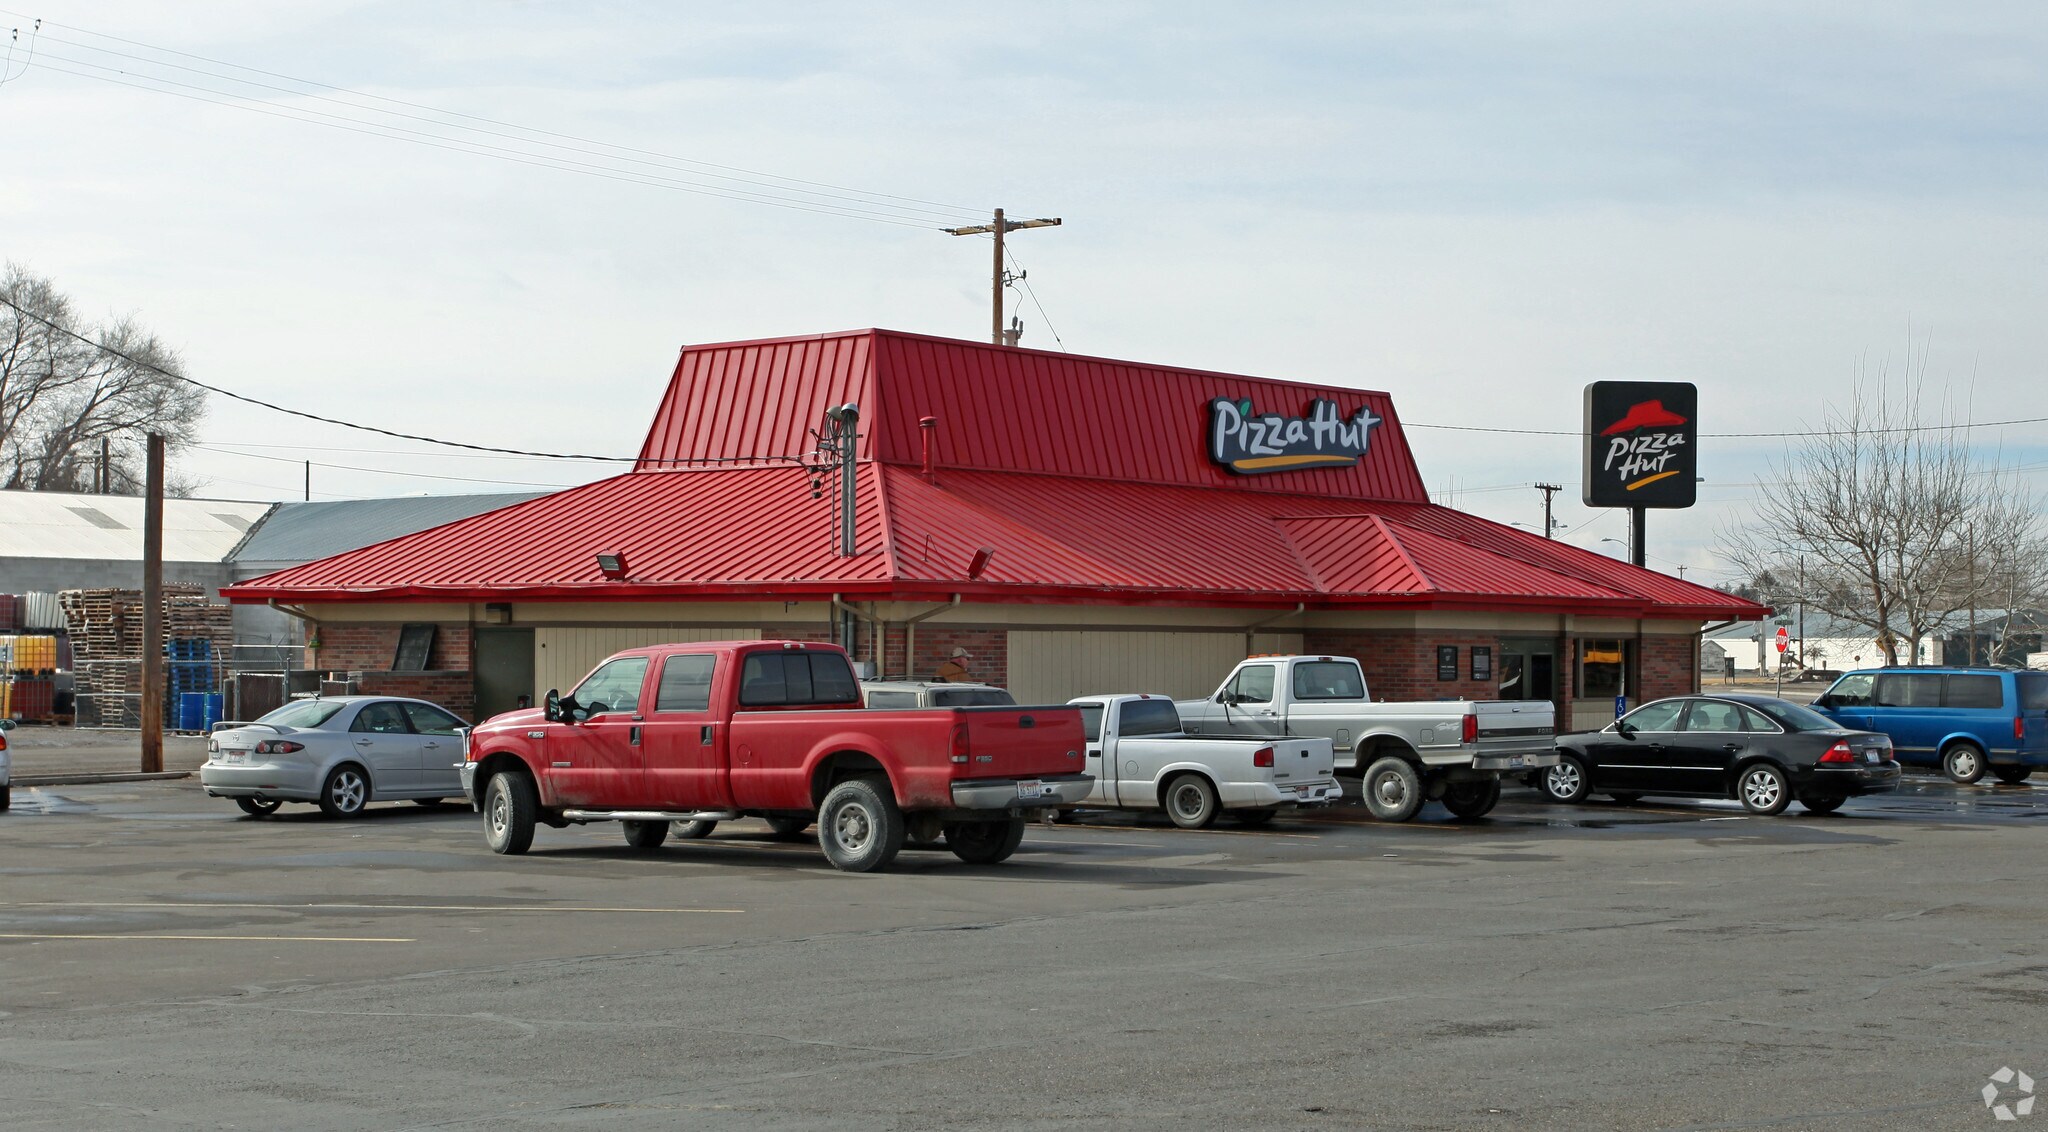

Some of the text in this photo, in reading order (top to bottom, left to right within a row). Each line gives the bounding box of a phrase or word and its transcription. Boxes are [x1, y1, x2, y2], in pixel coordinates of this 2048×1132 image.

[1216, 400, 1381, 458] Pizza Hut
[1604, 433, 1686, 471] Pizza
[1618, 450, 1677, 481] Hut
[1776, 634, 1788, 645] STOP
